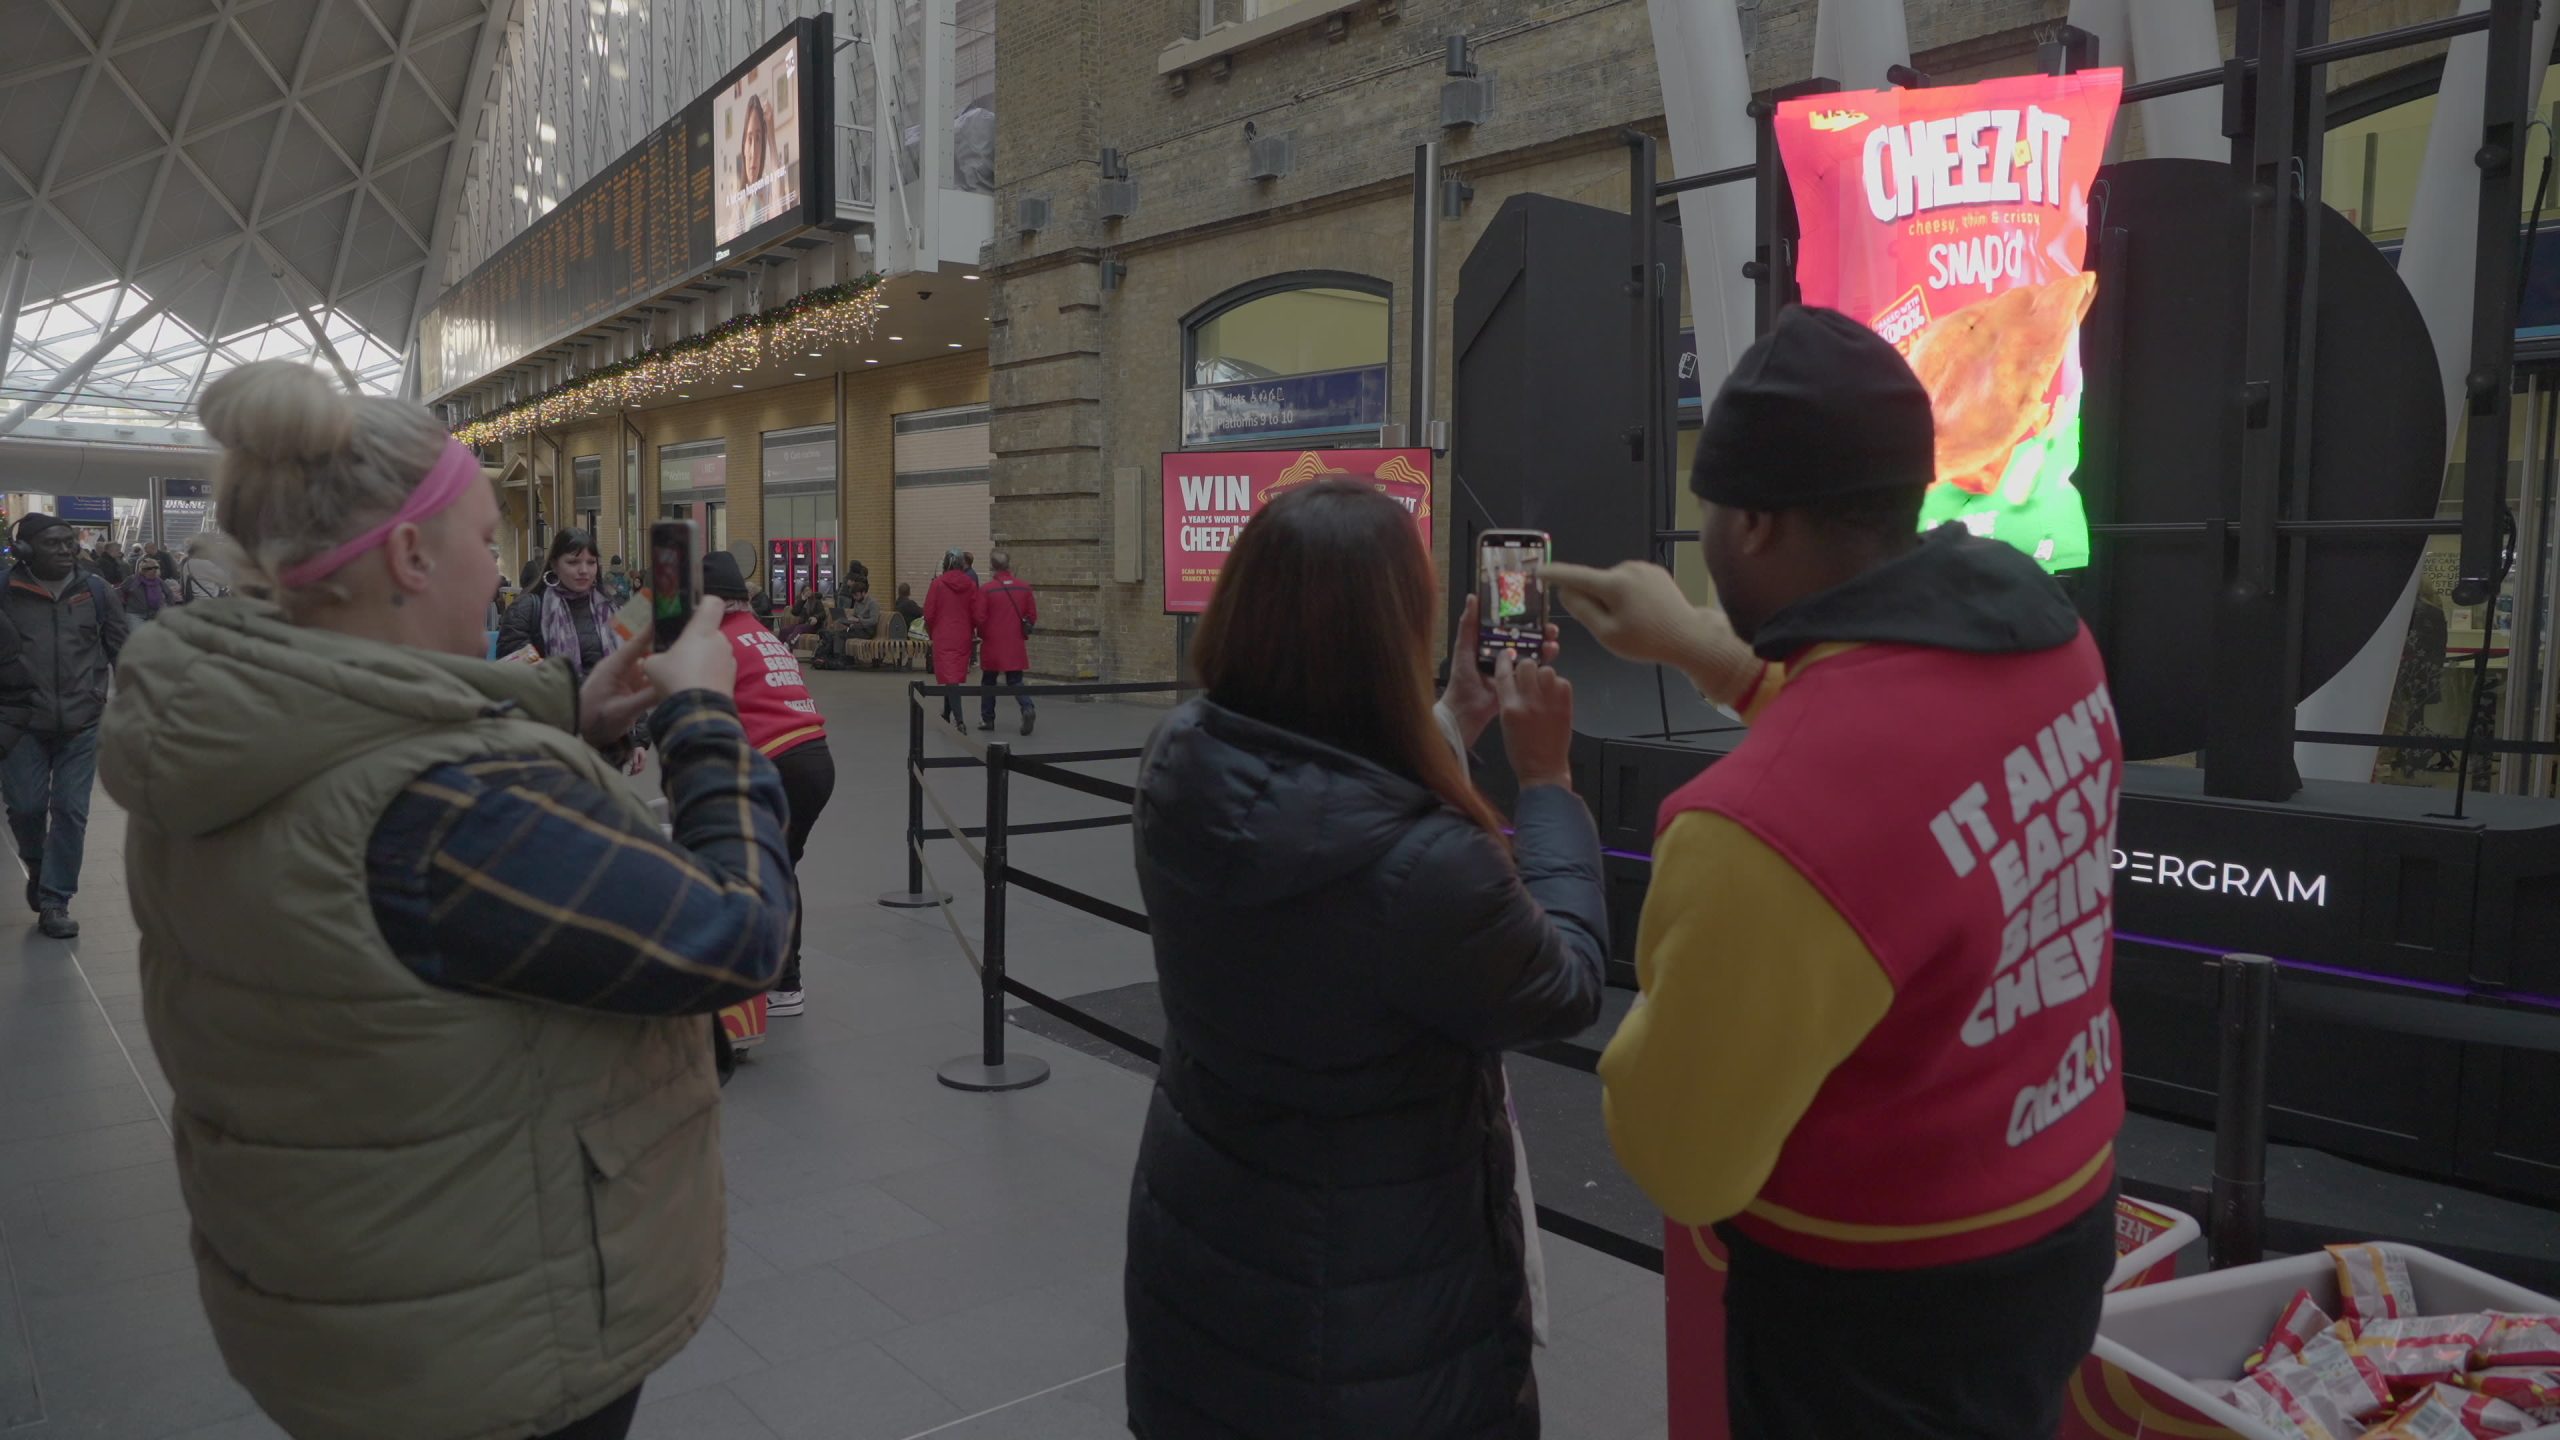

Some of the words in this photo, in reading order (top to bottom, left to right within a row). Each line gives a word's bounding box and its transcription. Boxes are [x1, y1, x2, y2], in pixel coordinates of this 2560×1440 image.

[1217, 393, 1246, 407] Toilets
[1217, 414, 1258, 430] Platforms
[1260, 413, 1266, 426] 9
[1269, 414, 1279, 425] to
[1281, 410, 1293, 424] 10
[1179, 476, 1250, 511] WIN
[1181, 516, 1187, 524] A
[1188, 515, 1212, 524] YEAR'S
[1213, 515, 1239, 524] WORTH
[1240, 515, 1251, 524] OF
[1180, 525, 1246, 552] CHEEZ-I
[737, 633, 757, 647] IT
[1929, 782, 1999, 878] IT
[1989, 759, 2112, 918] EASY
[1992, 787, 2119, 976] BEIN
